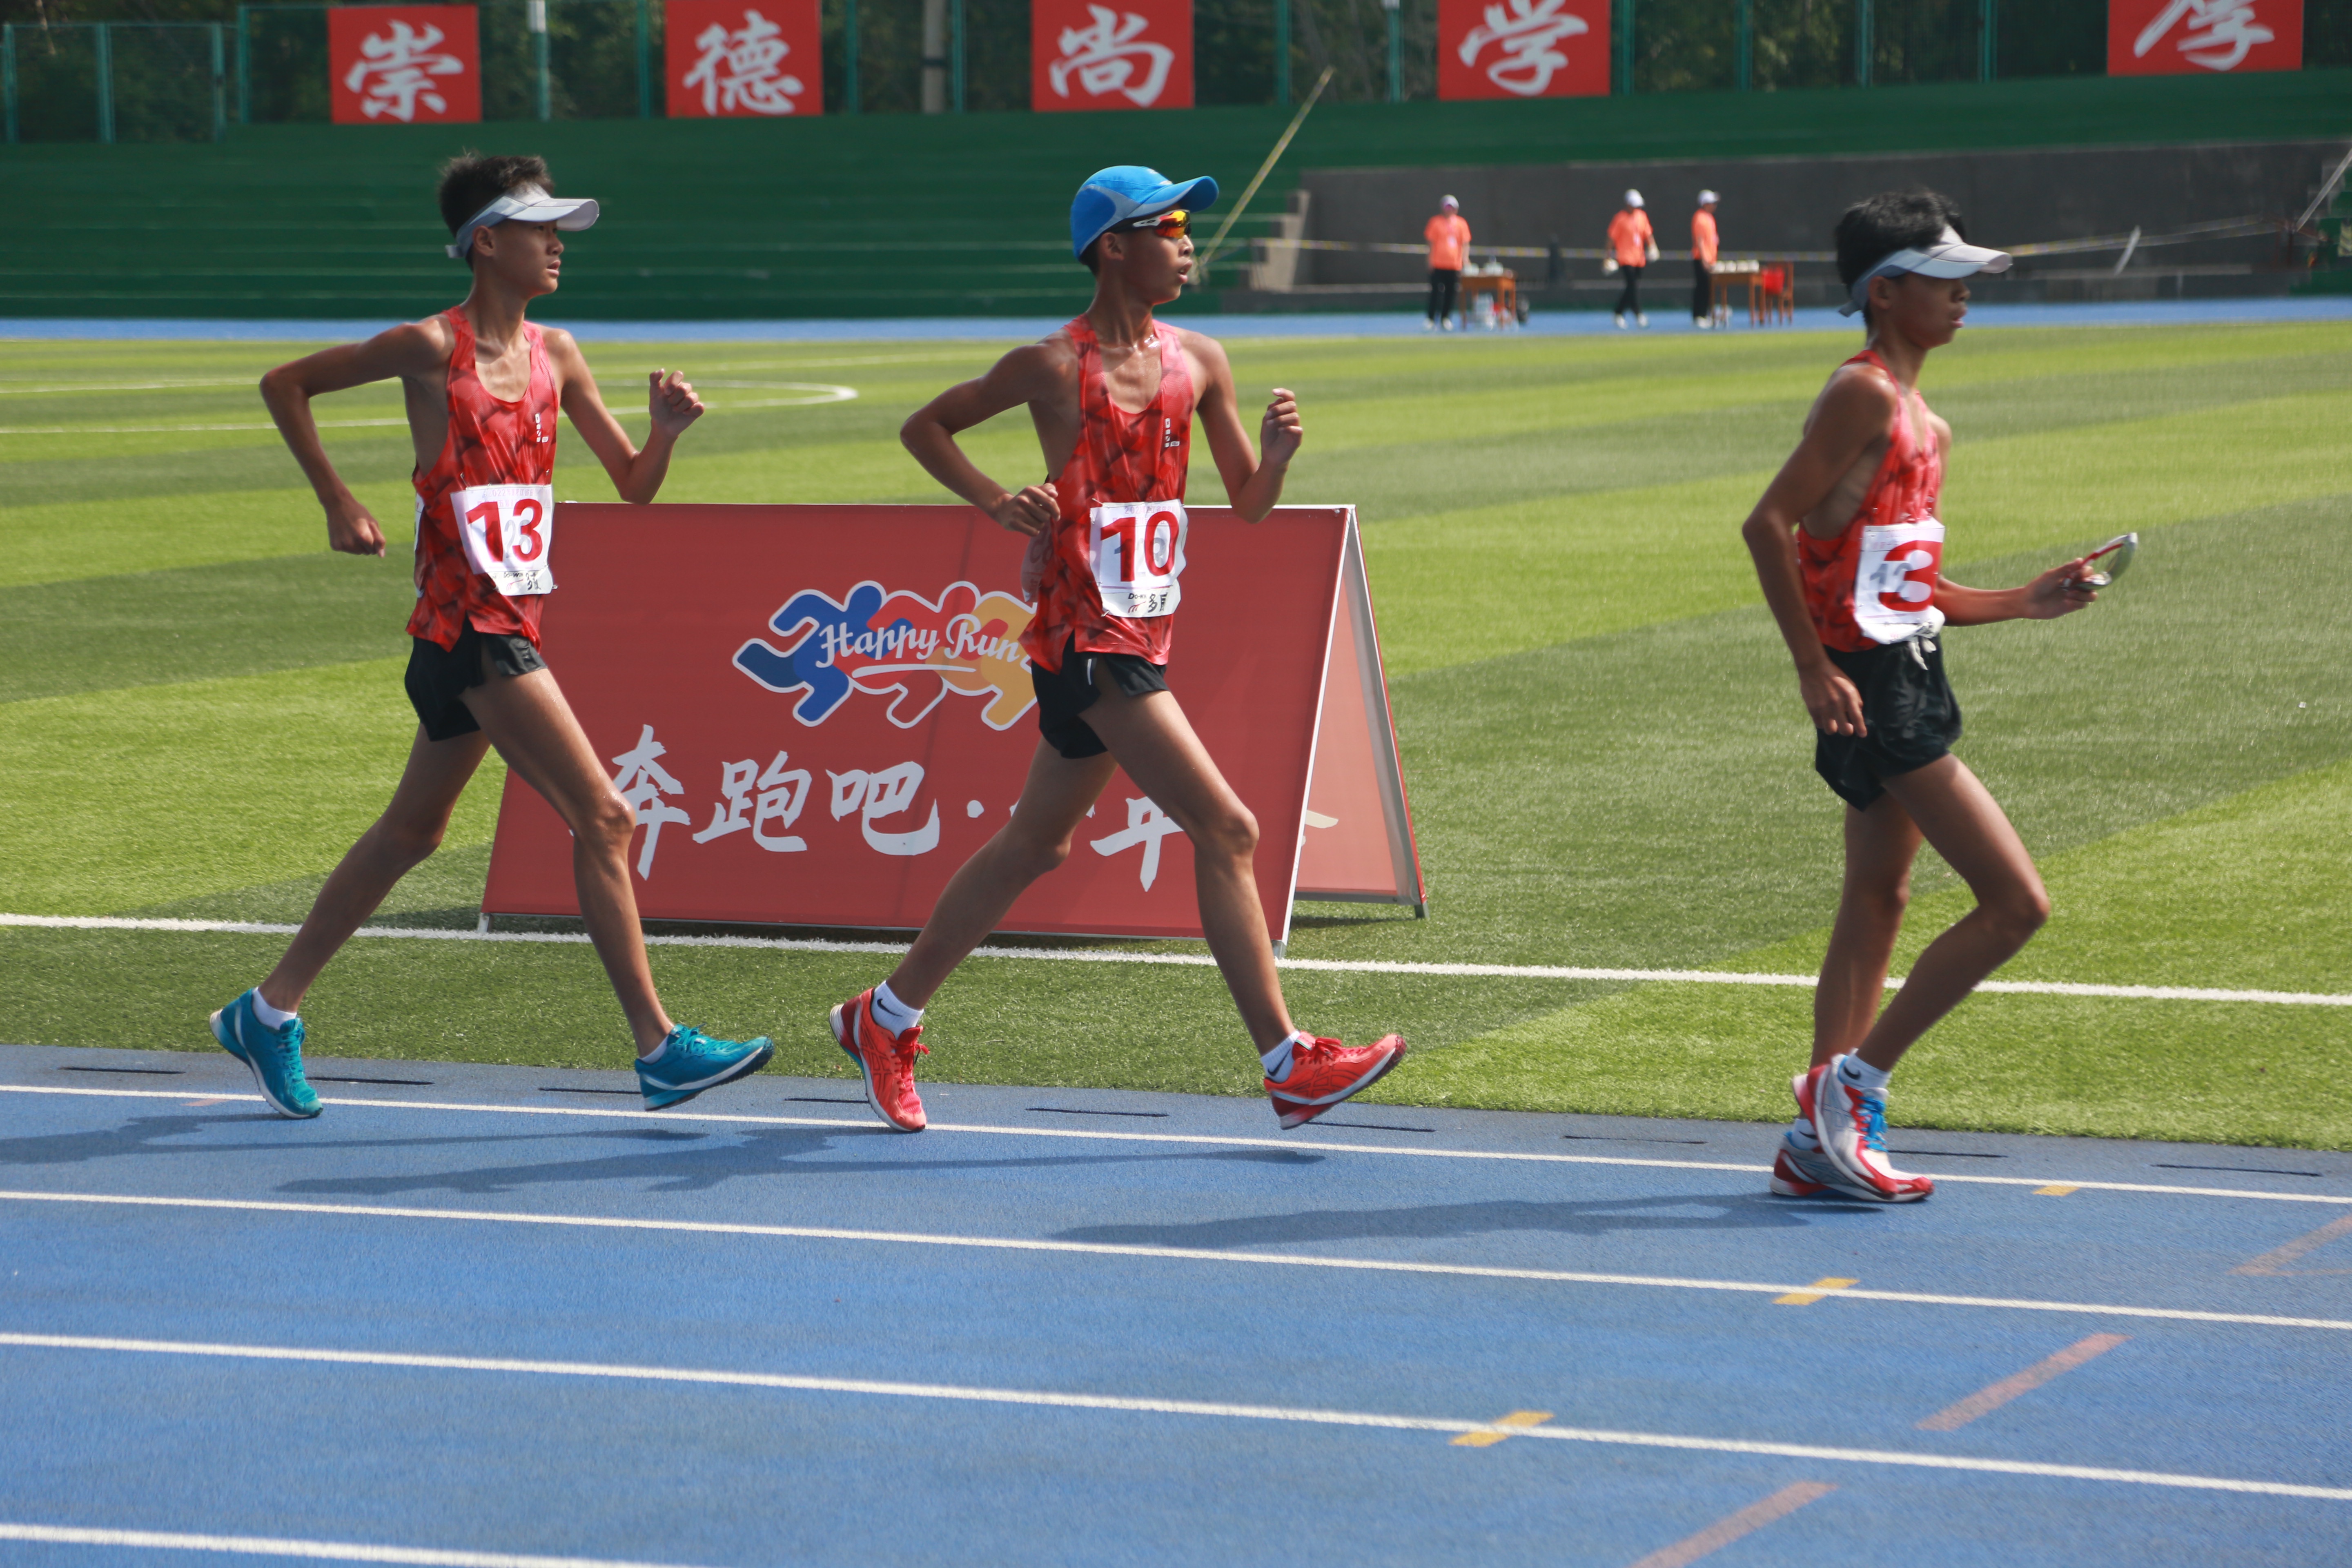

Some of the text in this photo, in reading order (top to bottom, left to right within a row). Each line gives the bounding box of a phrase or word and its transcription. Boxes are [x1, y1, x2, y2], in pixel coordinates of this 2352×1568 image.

[346, 20, 464, 121] 崇
[683, 10, 804, 116] 德
[1049, 4, 1174, 108] 尚
[1458, 0, 1589, 96] 学
[466, 499, 543, 562] 13
[1100, 511, 1179, 582] 10
[1878, 540, 1943, 612] 3
[816, 613, 1020, 668] Happy Run
